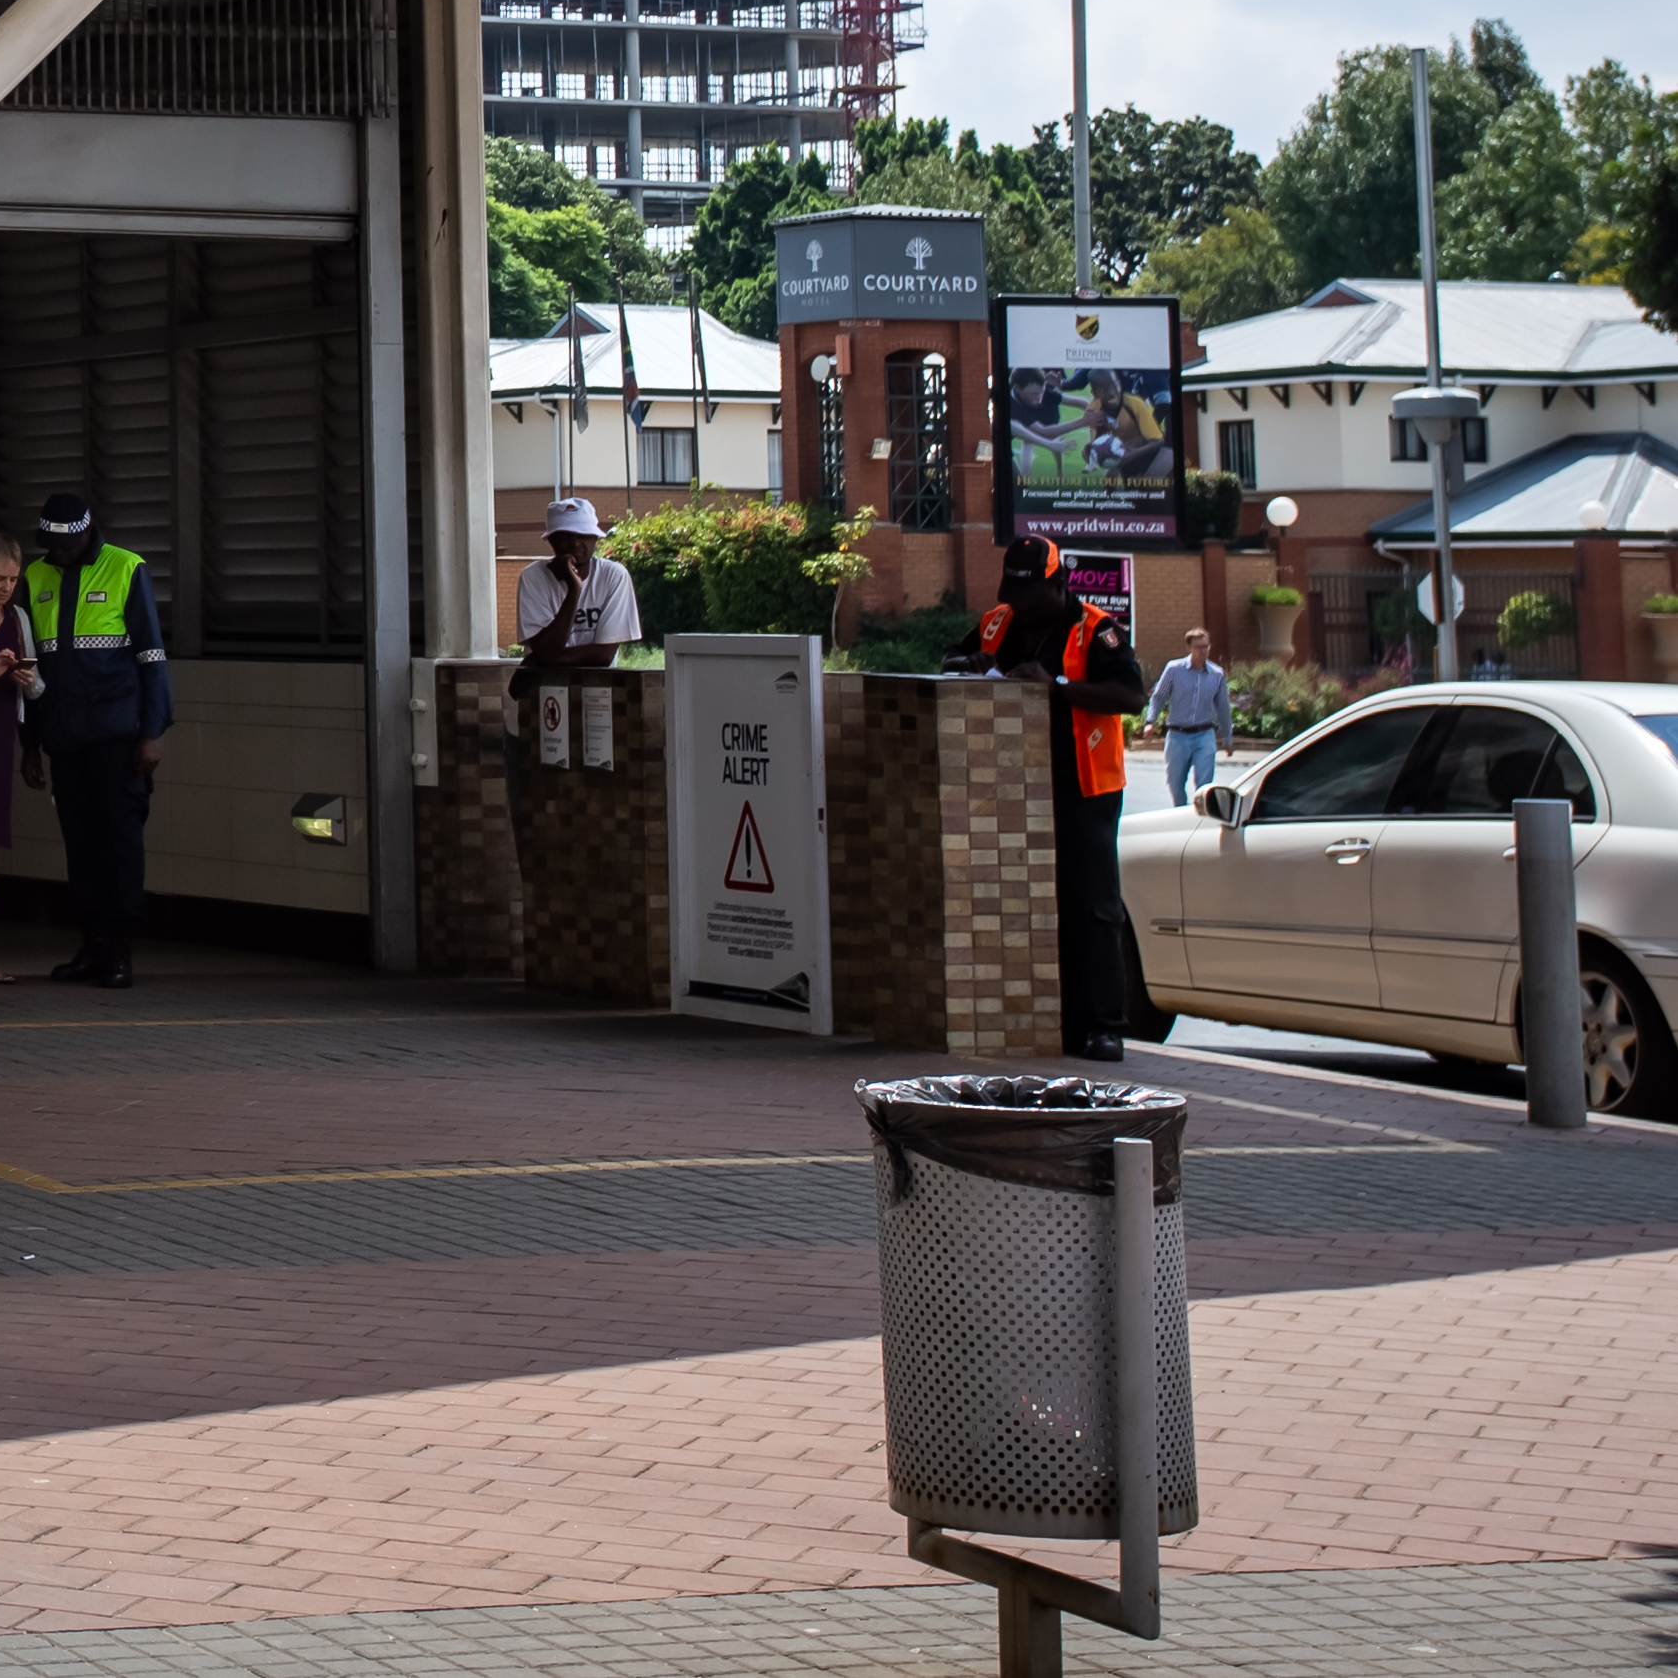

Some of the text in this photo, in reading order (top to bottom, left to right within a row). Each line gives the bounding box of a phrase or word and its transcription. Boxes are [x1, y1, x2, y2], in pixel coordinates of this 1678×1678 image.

[782, 275, 849, 296] COURTYARD
[863, 274, 978, 293] COURTYARD
[801, 296, 831, 307] HOTEL
[896, 293, 945, 306] HOTEL
[1066, 348, 1112, 359] PRIDWIN
[1017, 476, 1172, 488] HIS FUTURE IS OUR FUTURE
[1148, 491, 1165, 499] and
[1027, 518, 1165, 535] www.pridwin.co.za
[1068, 569, 1118, 585] MOVE
[1088, 595, 1109, 605] FUN
[1110, 596, 1129, 606] RUN
[574, 607, 602, 628] ep
[722, 723, 768, 752] CRIME
[722, 756, 770, 786] ALERT
